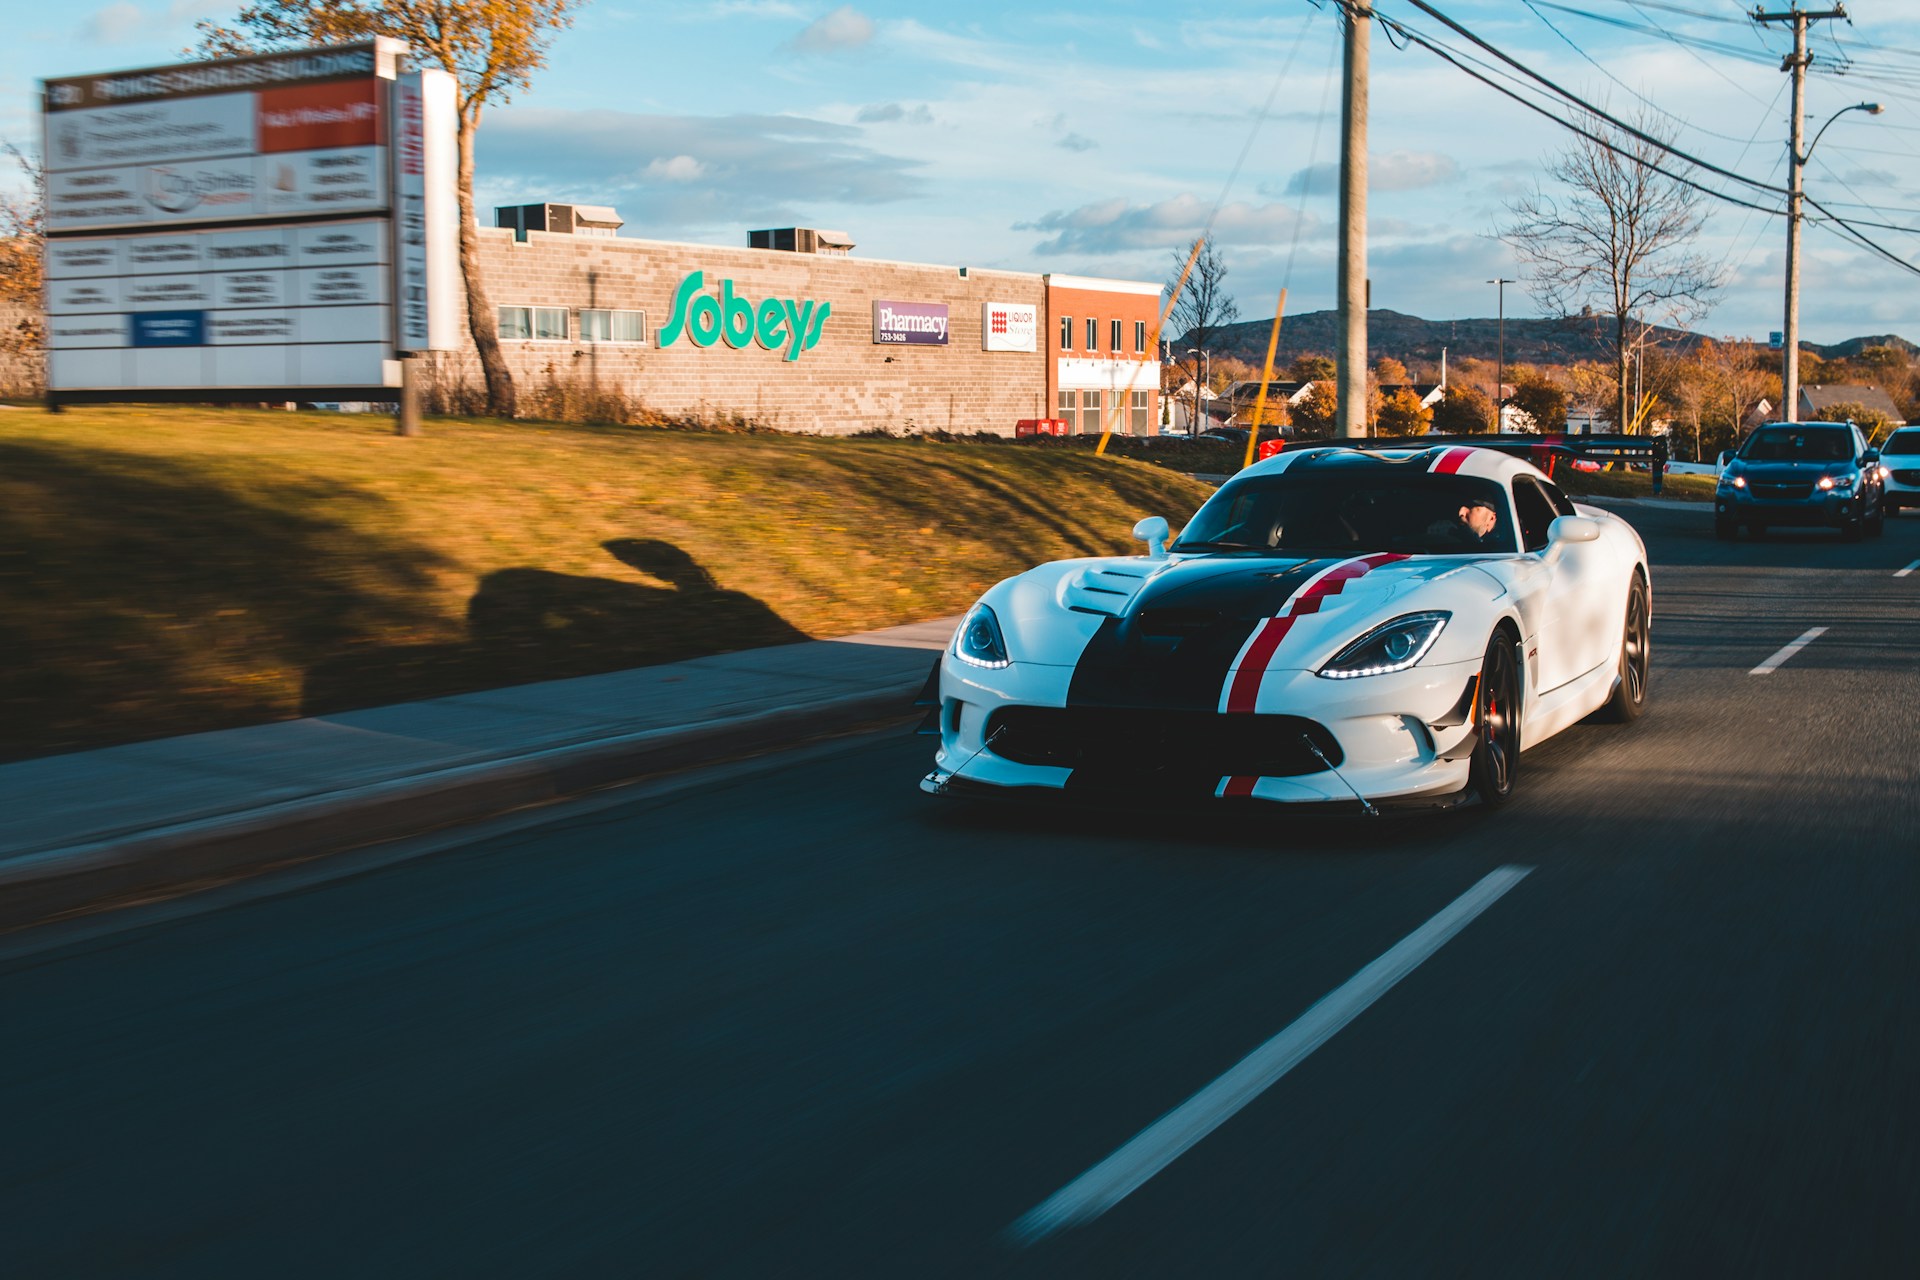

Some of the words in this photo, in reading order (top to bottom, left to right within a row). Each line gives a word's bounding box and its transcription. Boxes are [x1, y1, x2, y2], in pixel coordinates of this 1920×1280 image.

[656, 270, 831, 362] Sobeys
[880, 307, 947, 340] Pharmacy
[1008, 311, 1033, 323] LIQUOR
[880, 332, 907, 342] 753-3426
